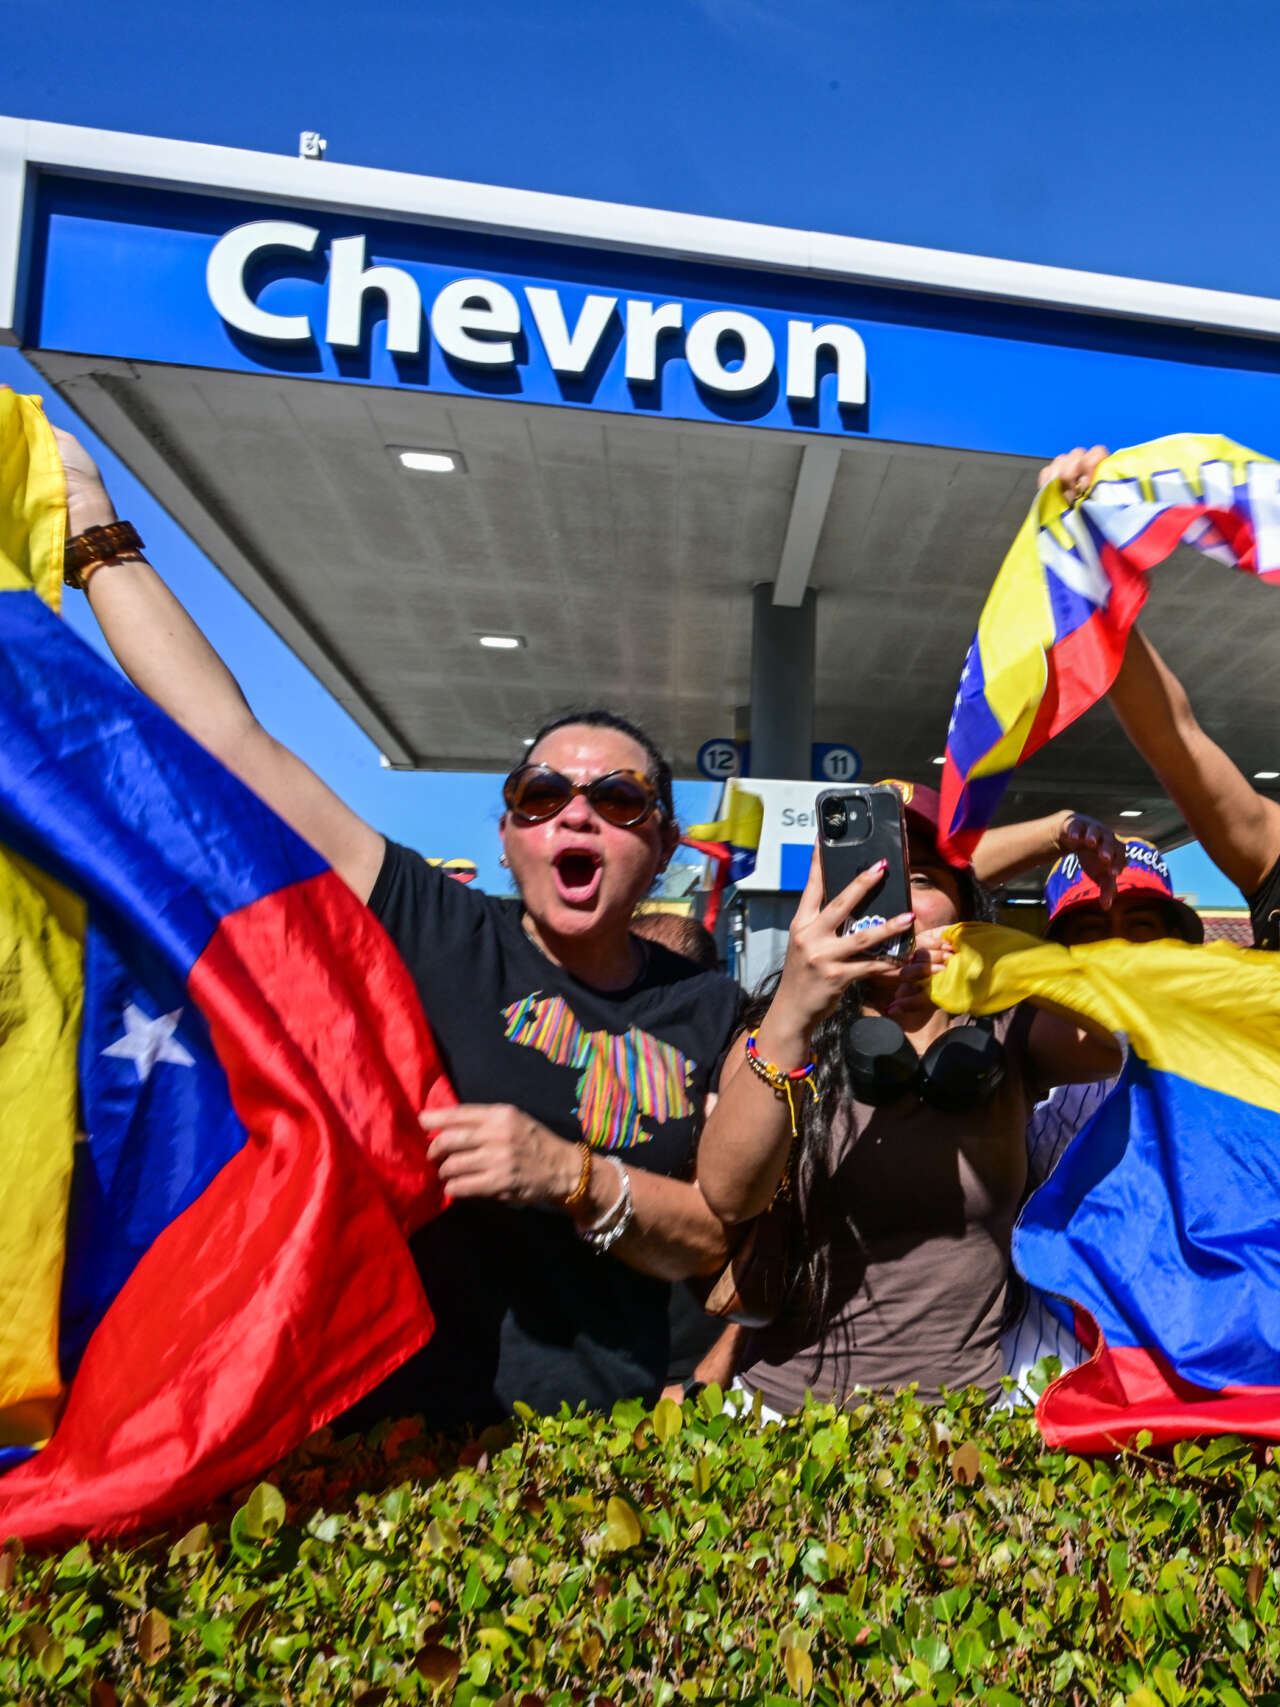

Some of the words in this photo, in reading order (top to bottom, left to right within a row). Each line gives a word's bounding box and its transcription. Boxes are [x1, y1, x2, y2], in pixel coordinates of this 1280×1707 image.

[205, 219, 867, 406] Chevron
[707, 751, 734, 770] 12
[830, 755, 847, 774] 11
[781, 808, 815, 827] Sel
[1061, 843, 1169, 878] Vuela
